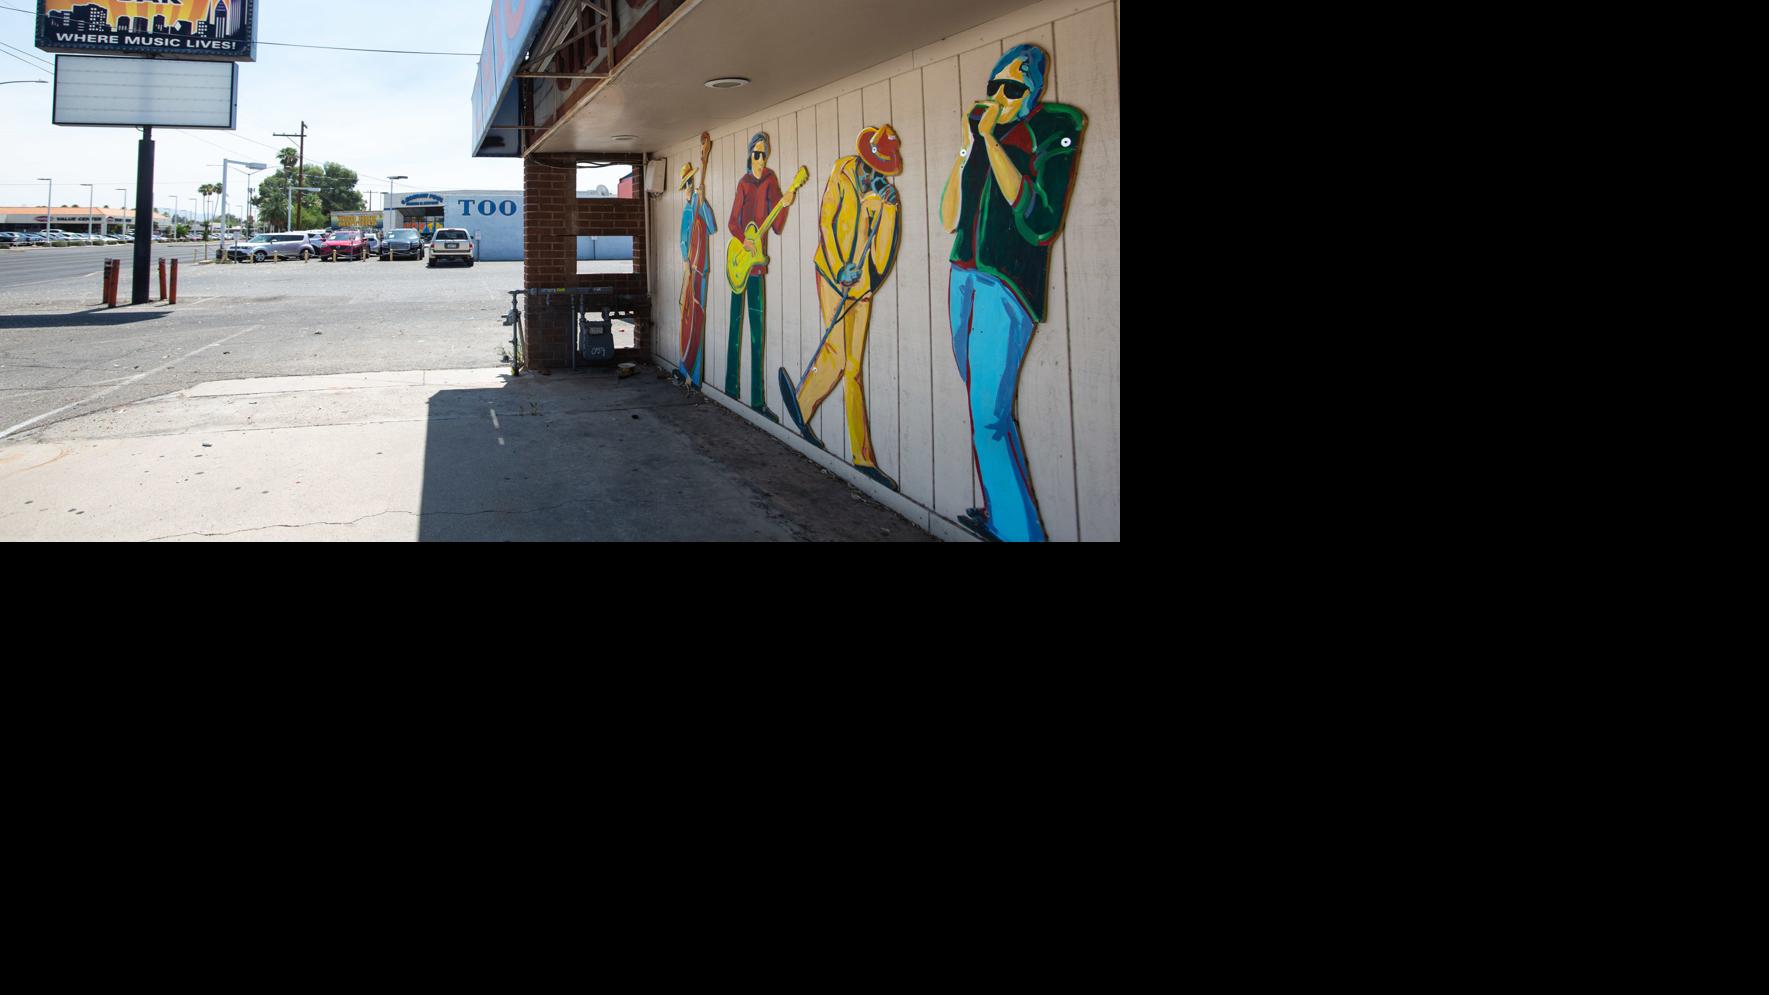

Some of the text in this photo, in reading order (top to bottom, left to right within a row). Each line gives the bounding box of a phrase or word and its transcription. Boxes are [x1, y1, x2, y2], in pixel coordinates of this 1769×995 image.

[56, 33, 236, 50] WHERE MUSIC LIVES!
[458, 199, 517, 216] TOO
